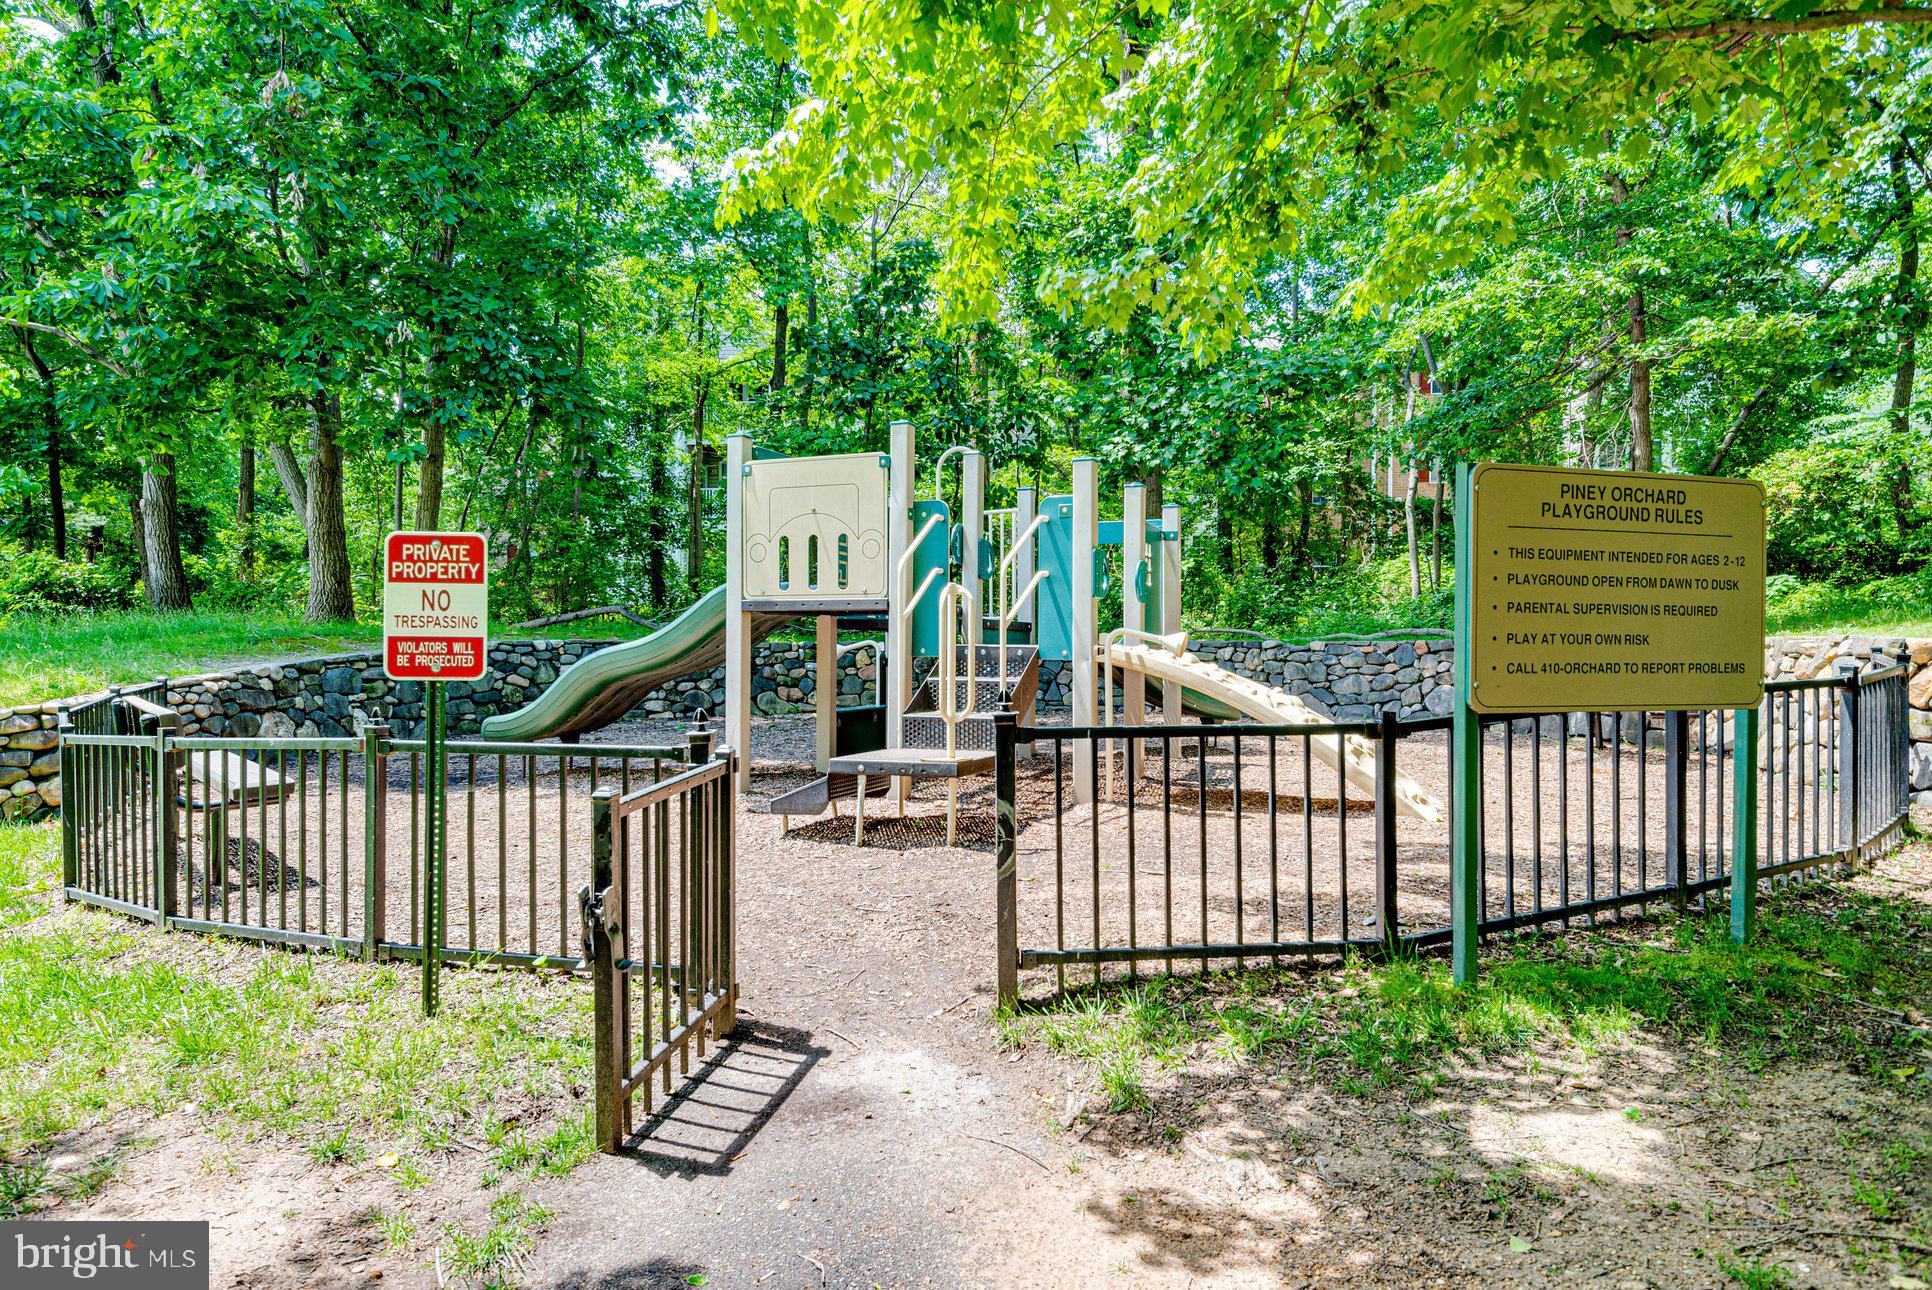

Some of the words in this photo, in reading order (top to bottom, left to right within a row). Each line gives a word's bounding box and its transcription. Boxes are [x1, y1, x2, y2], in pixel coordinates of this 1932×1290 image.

[1560, 484, 1607, 501] PINEY
[1611, 487, 1686, 505] ORCHARD
[1542, 503, 1650, 522] PLAYGROUND
[1655, 509, 1703, 525] RULES
[402, 544, 470, 561] PRIVATE
[1508, 547, 1535, 560] THIS
[1538, 548, 1605, 562] EQUIPMENT
[1609, 551, 1663, 563] INTENDED
[1666, 553, 1688, 564] FOR
[1691, 554, 1719, 565] AGES
[392, 562, 480, 579] PROPERTY
[1507, 573, 1589, 587] PLAYGROUND
[1592, 576, 1623, 587] OPEN
[1626, 576, 1657, 588] FROM
[1660, 578, 1692, 589] DAWN
[1694, 579, 1708, 590] TO
[1711, 579, 1739, 591] DUSK
[422, 590, 451, 611] NO
[1507, 602, 1570, 614] PARENTAL
[1573, 603, 1648, 615] SUPERVISION
[1651, 605, 1661, 616] IS
[1663, 605, 1718, 617] REQUIRED
[394, 615, 478, 629] TRESPASSING
[1507, 633, 1538, 644] PLAY
[1541, 633, 1556, 644] AT
[1560, 633, 1592, 645] YOUR
[1595, 634, 1621, 645] OWN
[1625, 634, 1649, 645] RISK
[397, 642, 447, 653] VIOLATORS
[453, 642, 474, 654] WILL
[397, 655, 410, 666] BE
[415, 655, 474, 667] PROSECUTED
[1506, 663, 1537, 674] CALL
[1540, 663, 1620, 674] 410-ORCHARD
[1624, 663, 1639, 674] TO
[1642, 663, 1685, 674] REPORT
[1688, 663, 1745, 674] PROBLEMS
